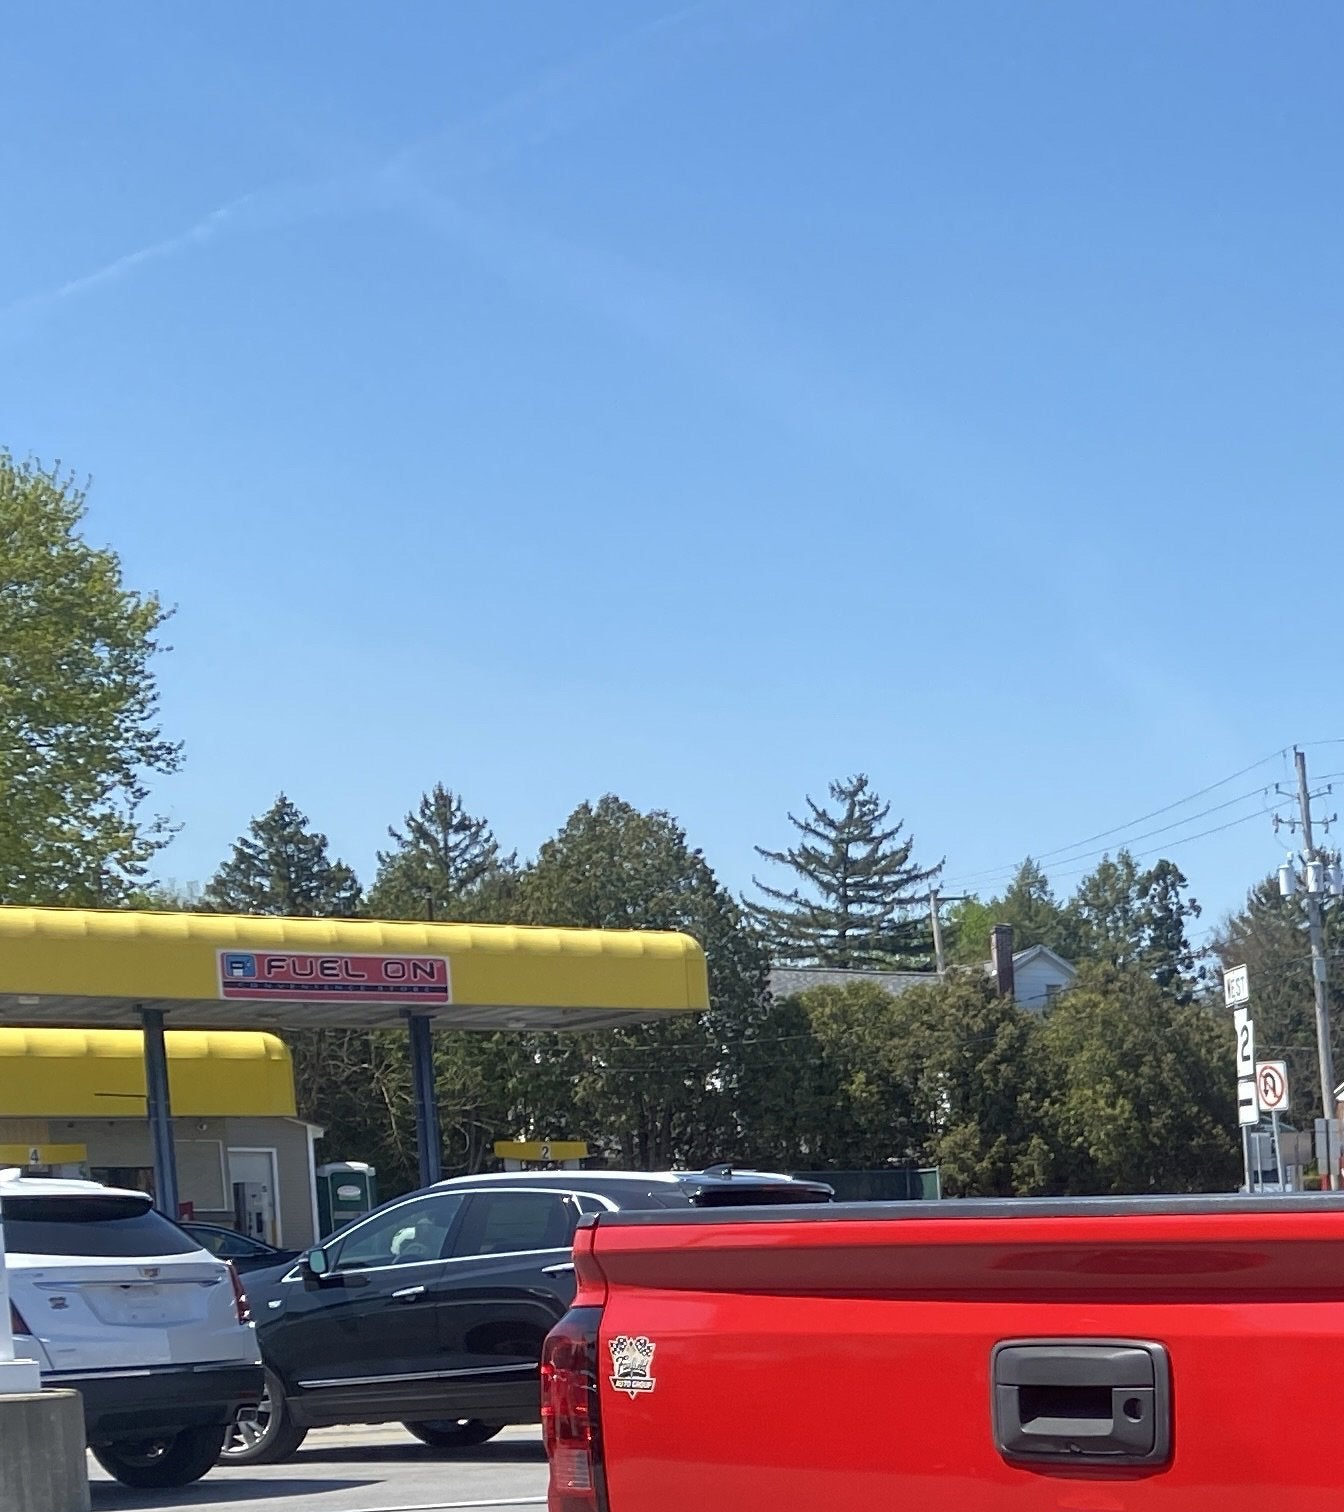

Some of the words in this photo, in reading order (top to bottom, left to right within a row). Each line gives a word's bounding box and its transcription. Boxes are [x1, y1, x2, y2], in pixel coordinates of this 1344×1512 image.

[265, 957, 368, 980] FUEL
[381, 959, 437, 981] ON
[31, 1149, 39, 1164] 4
[542, 1146, 549, 1160] 2
